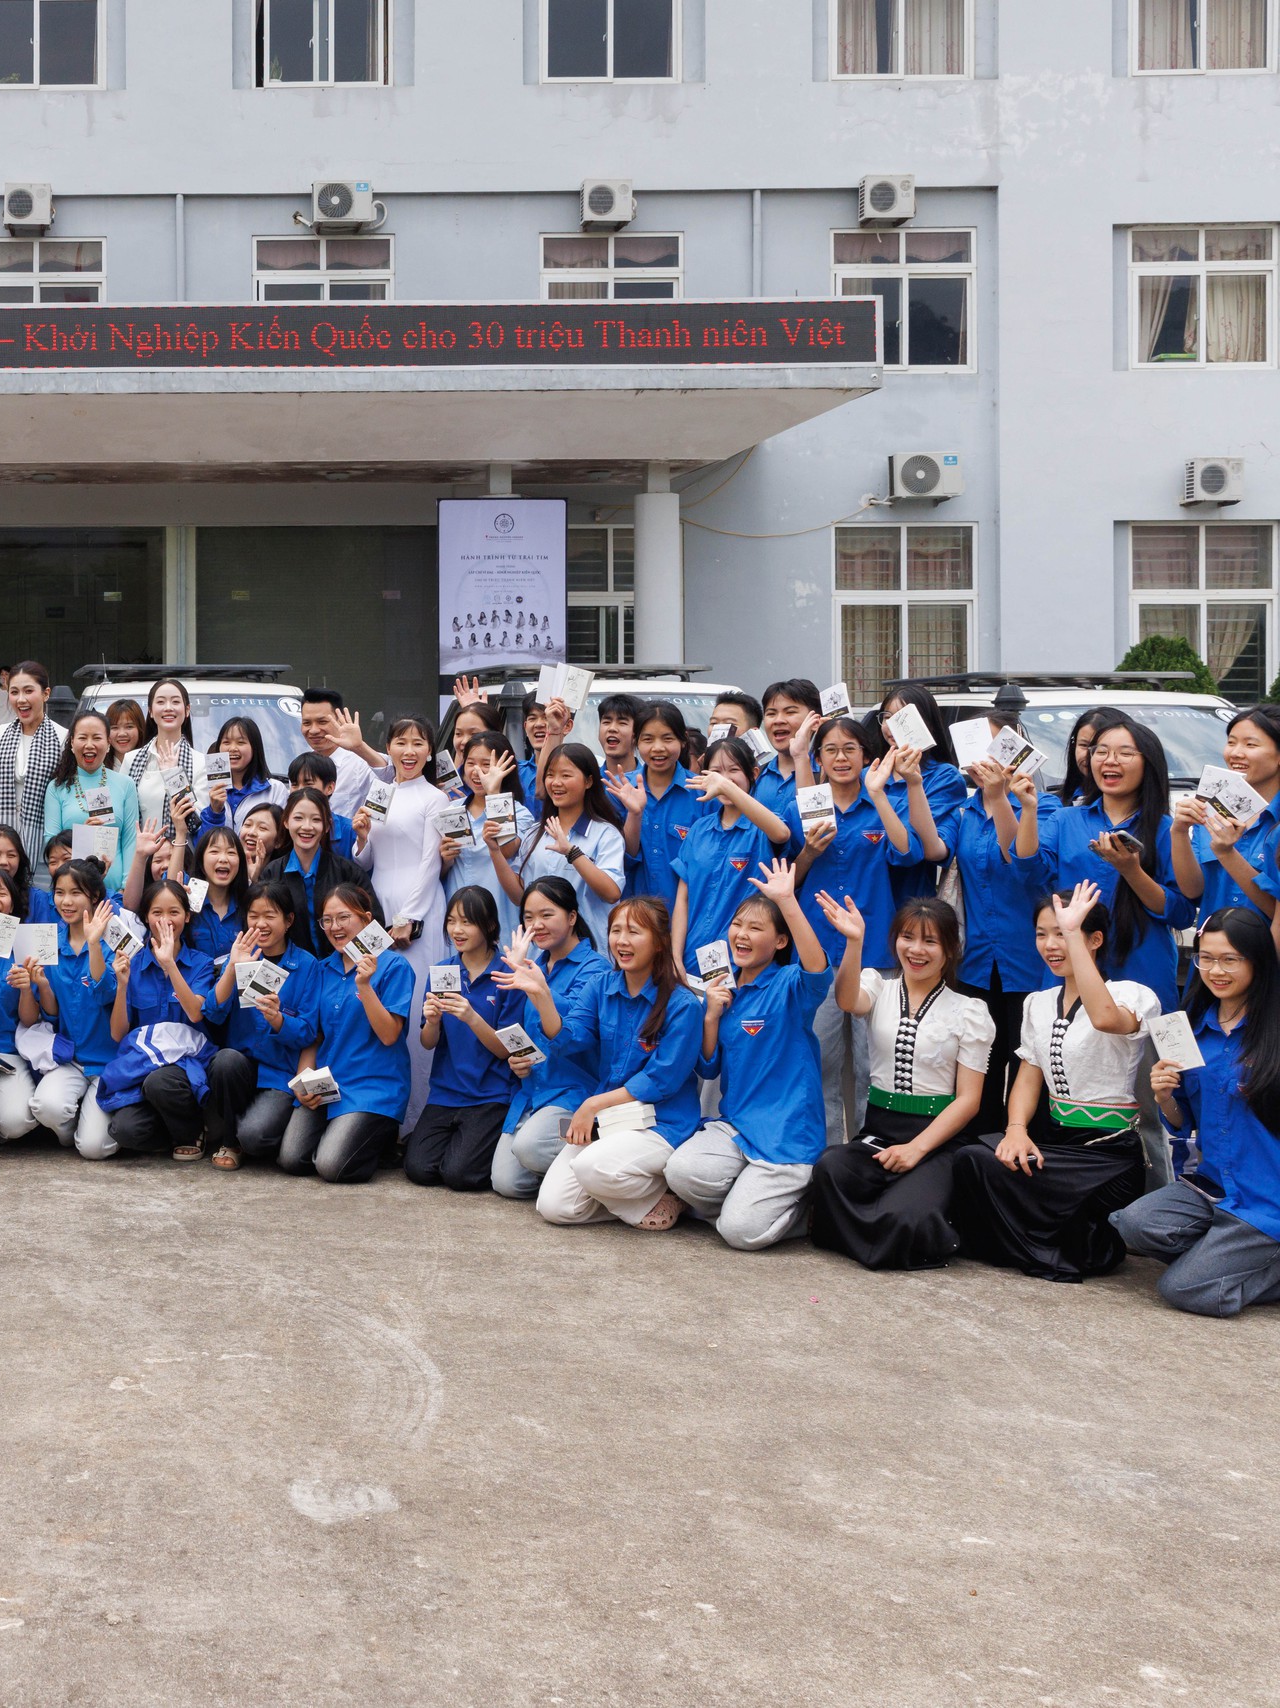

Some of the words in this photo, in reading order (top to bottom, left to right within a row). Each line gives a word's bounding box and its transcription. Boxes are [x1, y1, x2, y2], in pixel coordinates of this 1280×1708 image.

[24, 324, 98, 351] Khởi
[108, 323, 219, 358] Nghiệp
[229, 314, 300, 350] Kiến
[311, 314, 391, 357] Quốc
[402, 322, 456, 349] cho
[468, 321, 504, 349] 30
[514, 321, 584, 351] triệu
[594, 320, 691, 348] Thanh
[702, 319, 768, 347] niên
[778, 318, 846, 349] Việt
[210, 697, 271, 707] COFFEE!
[283, 701, 302, 713] 12
